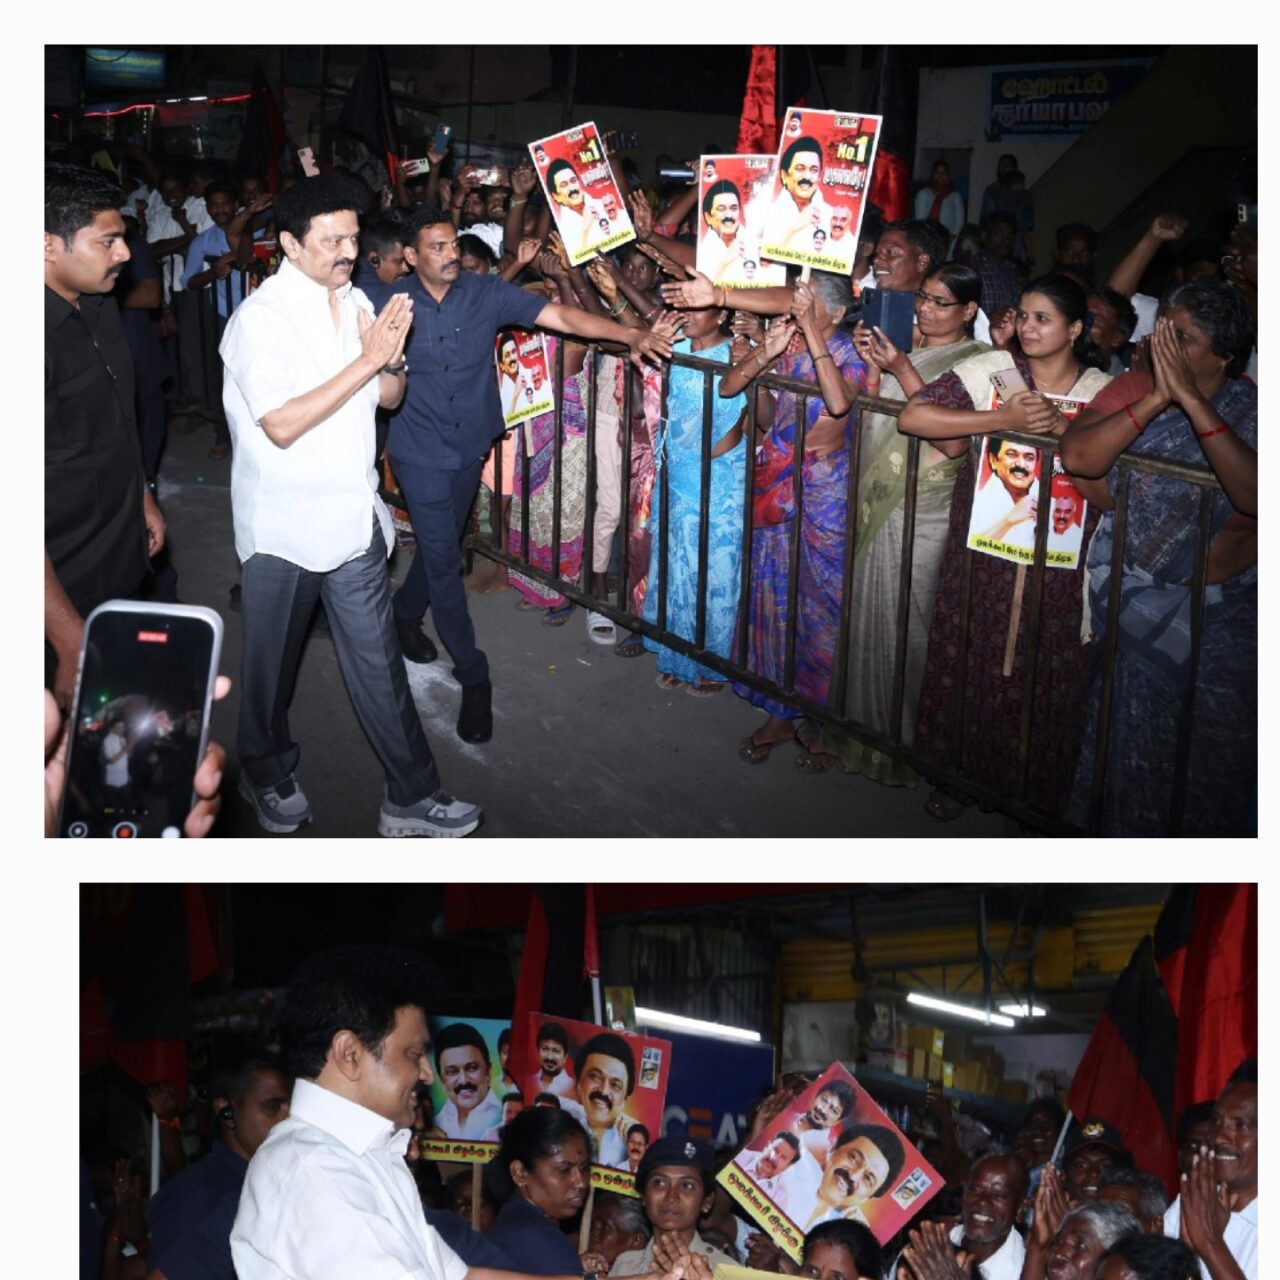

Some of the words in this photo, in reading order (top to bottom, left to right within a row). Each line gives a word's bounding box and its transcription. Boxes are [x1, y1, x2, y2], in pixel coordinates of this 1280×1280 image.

[661, 1104, 748, 1149] CEA
[603, 1173, 636, 1190] ஒன்றி
[767, 1214, 799, 1249] கிழக்கு
